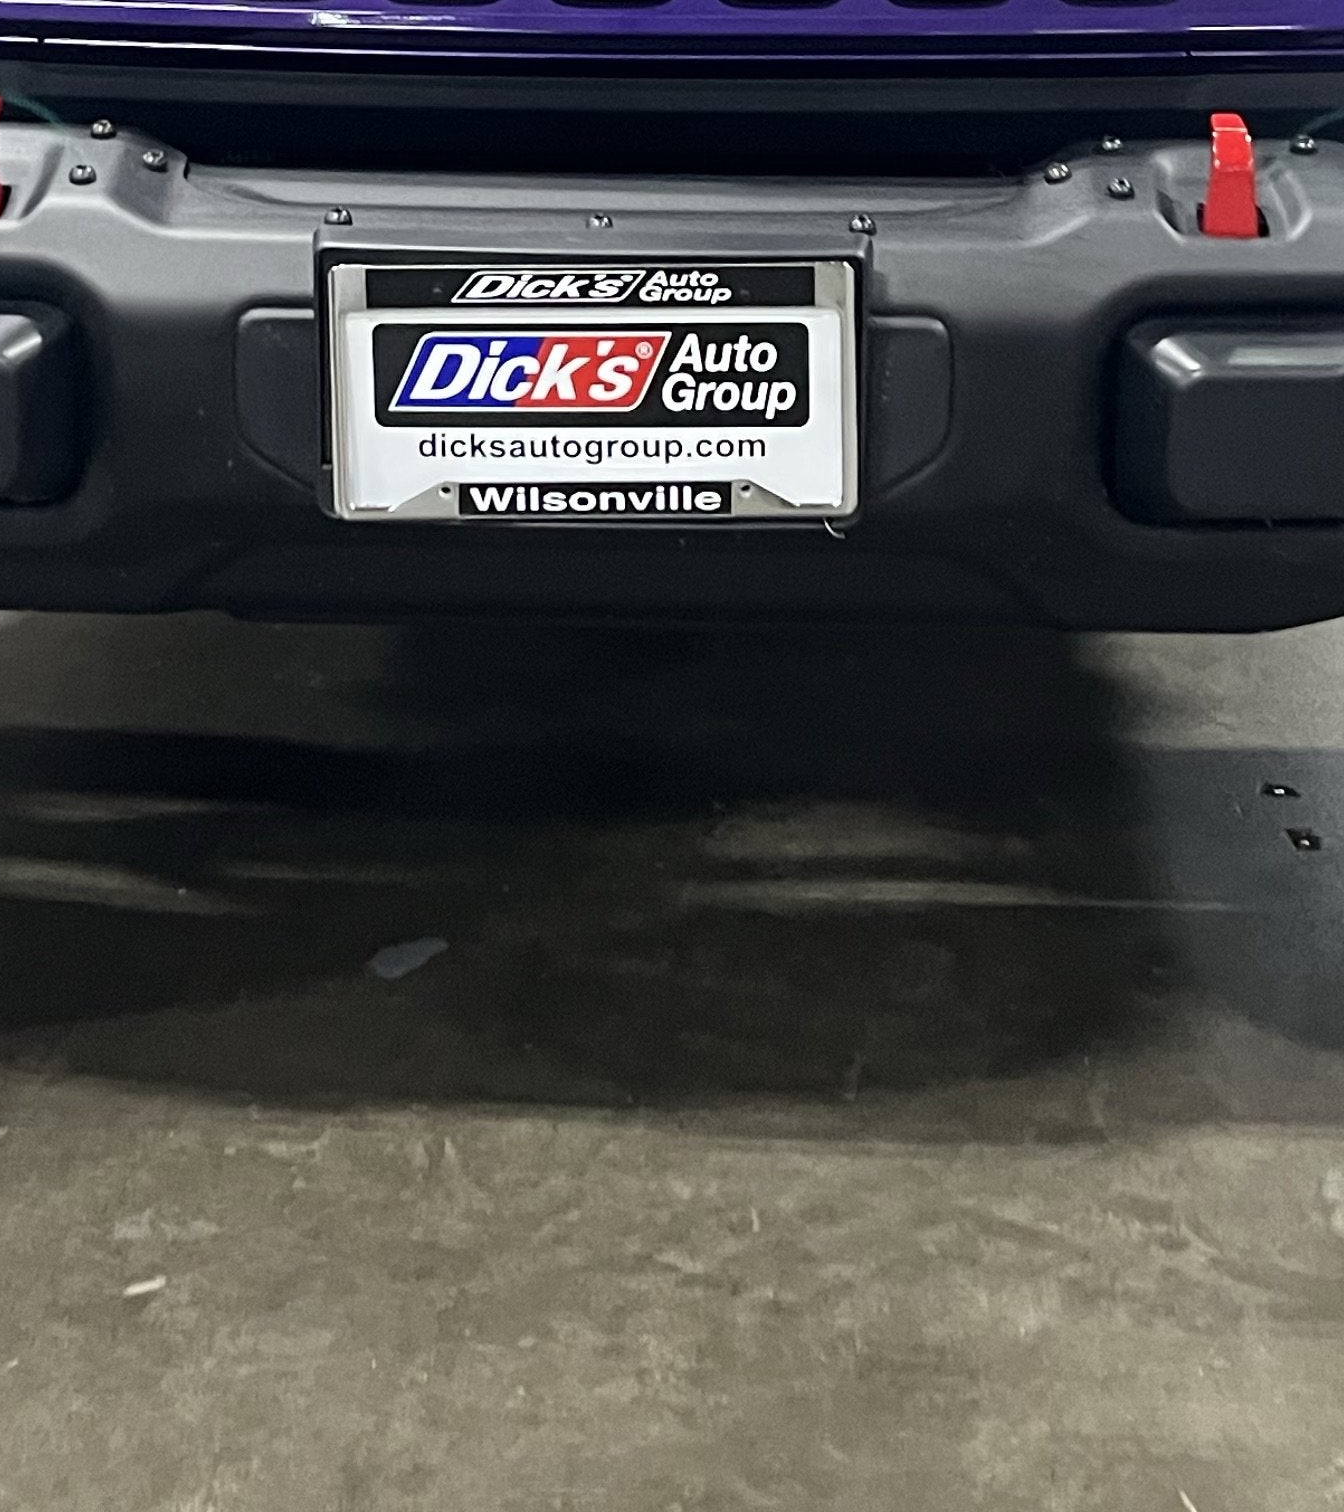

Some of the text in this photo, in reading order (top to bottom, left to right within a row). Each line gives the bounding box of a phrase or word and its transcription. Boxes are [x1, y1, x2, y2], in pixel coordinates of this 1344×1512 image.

[645, 270, 719, 287] Auto
[638, 286, 732, 305] Group
[668, 332, 779, 373] Auto
[661, 372, 798, 420] Group
[418, 433, 767, 465] dicksautogroup.com
[469, 485, 722, 513] Wilsonville
